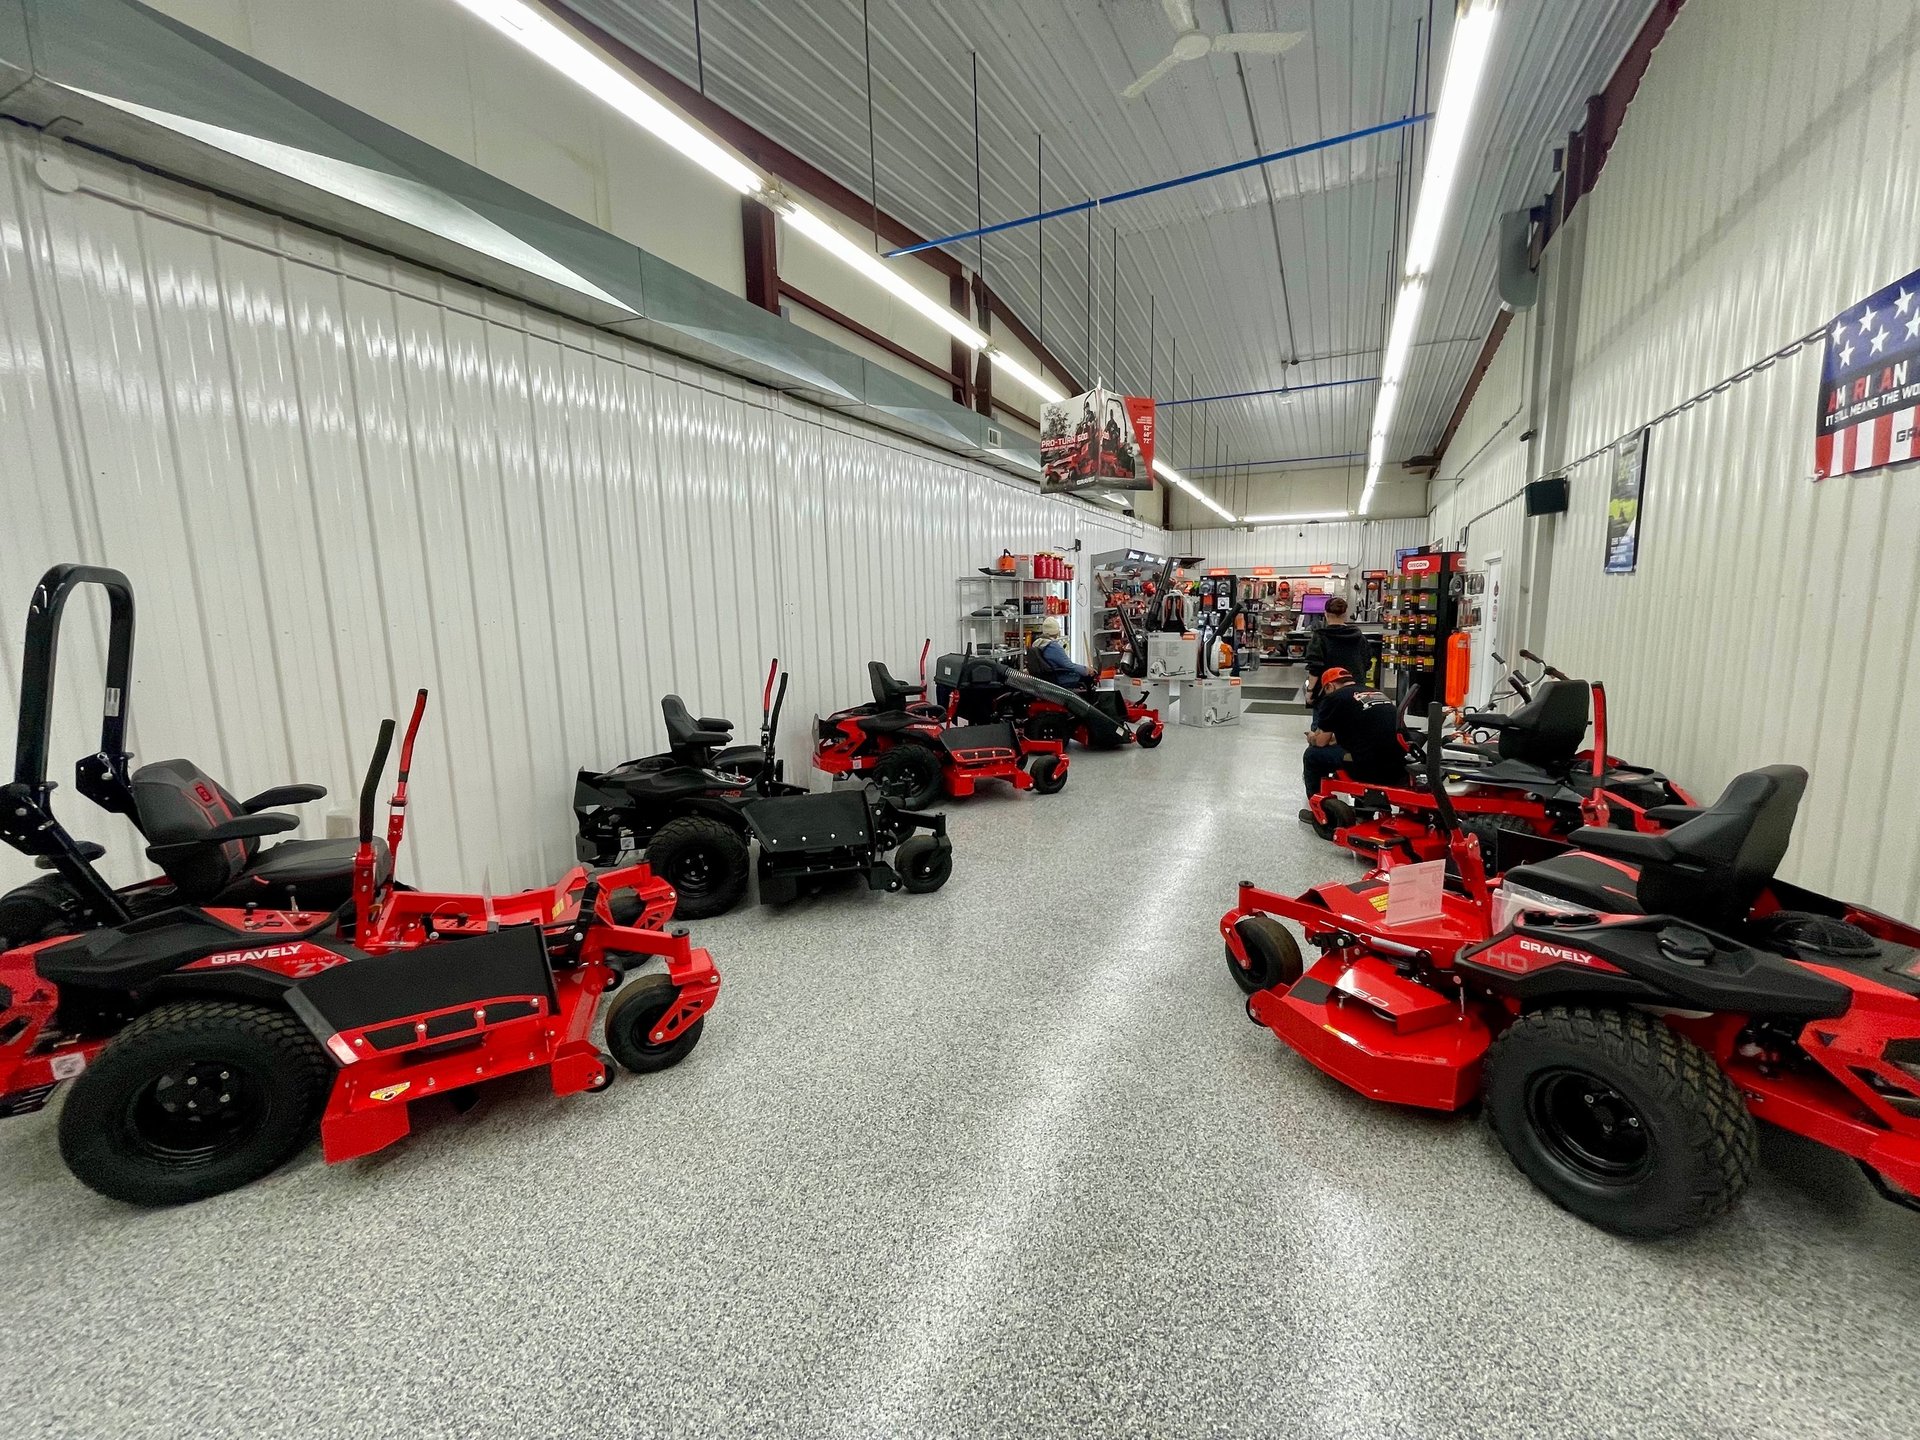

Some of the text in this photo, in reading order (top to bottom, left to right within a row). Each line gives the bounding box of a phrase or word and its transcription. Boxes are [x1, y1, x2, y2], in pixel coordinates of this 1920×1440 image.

[1825, 415, 1834, 427] IT
[1849, 397, 1880, 417] MEANS
[1881, 390, 1900, 406] THE
[1901, 383, 1920, 400] WO
[1041, 435, 1076, 448] PRO-TURN
[211, 944, 302, 965] GRAVELY
[283, 955, 338, 966] PRO-TURN
[1486, 948, 1529, 972] HD
[1519, 940, 1593, 964] GRAVELY
